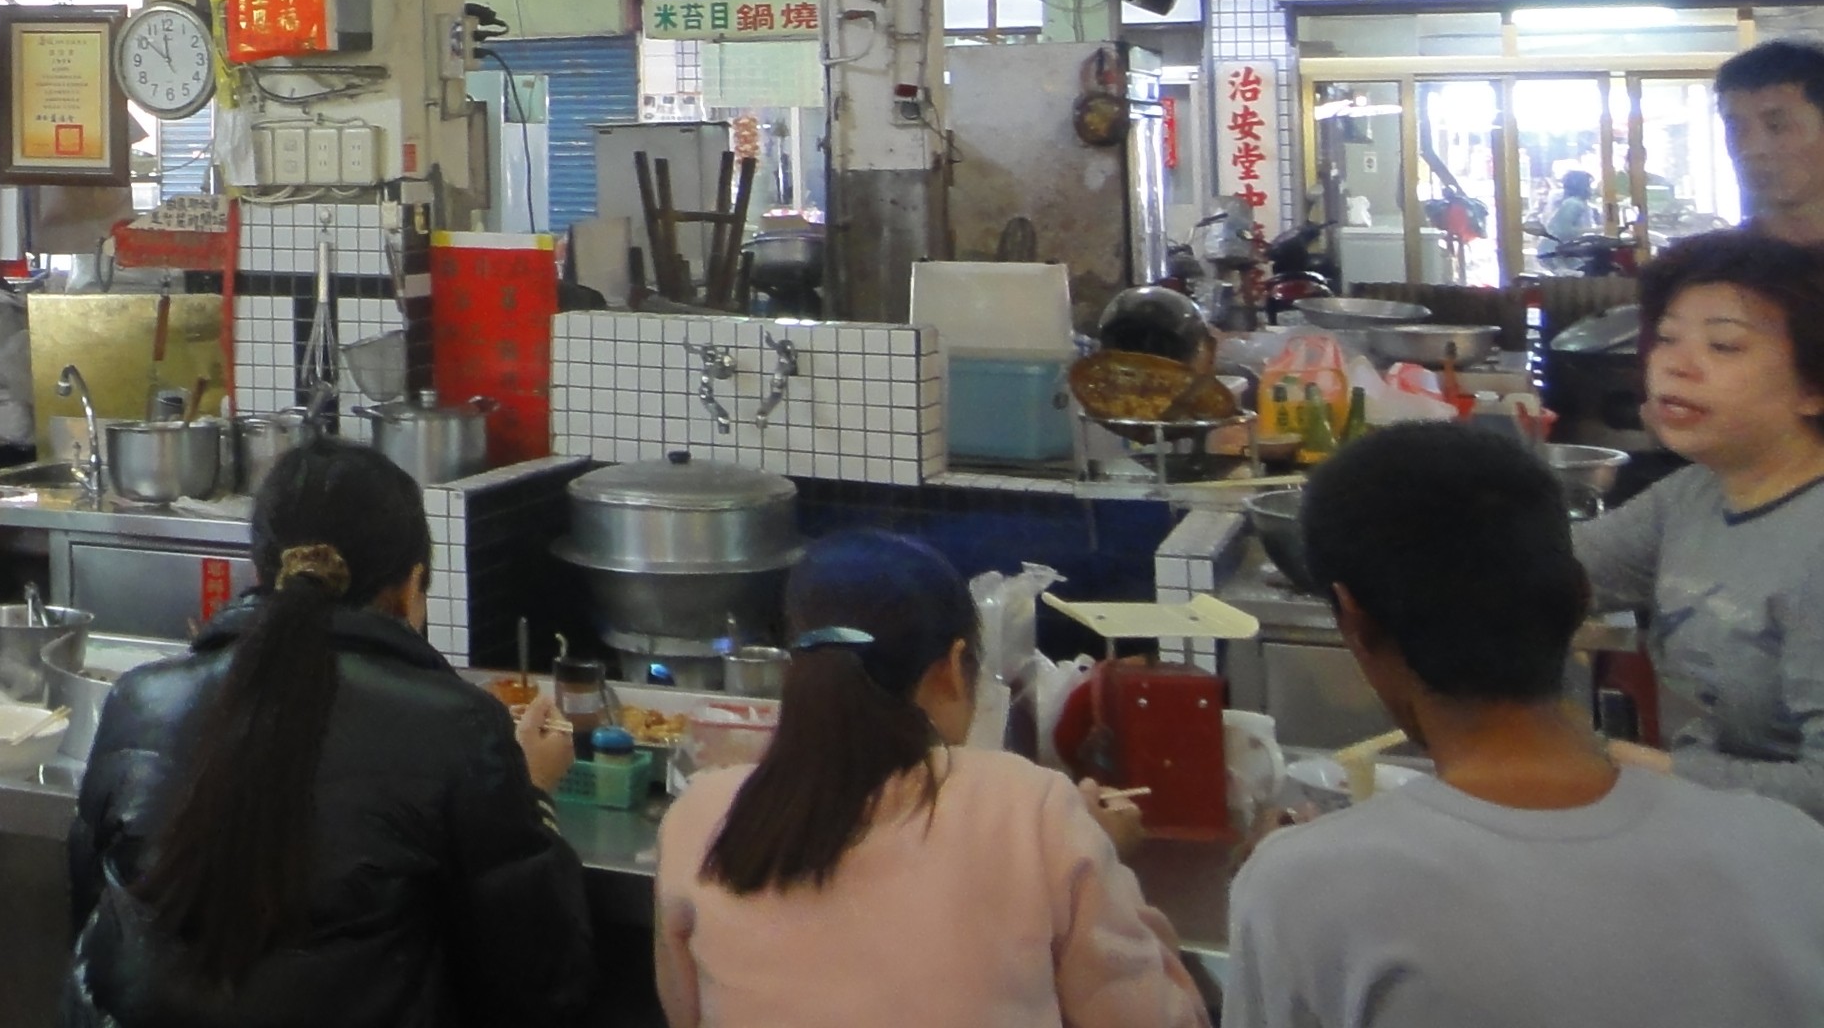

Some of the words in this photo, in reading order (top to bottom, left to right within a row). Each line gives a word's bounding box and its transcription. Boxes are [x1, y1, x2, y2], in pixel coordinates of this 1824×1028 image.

[653, 1, 729, 32] 米苔目
[736, 1, 819, 32] 鍋燒
